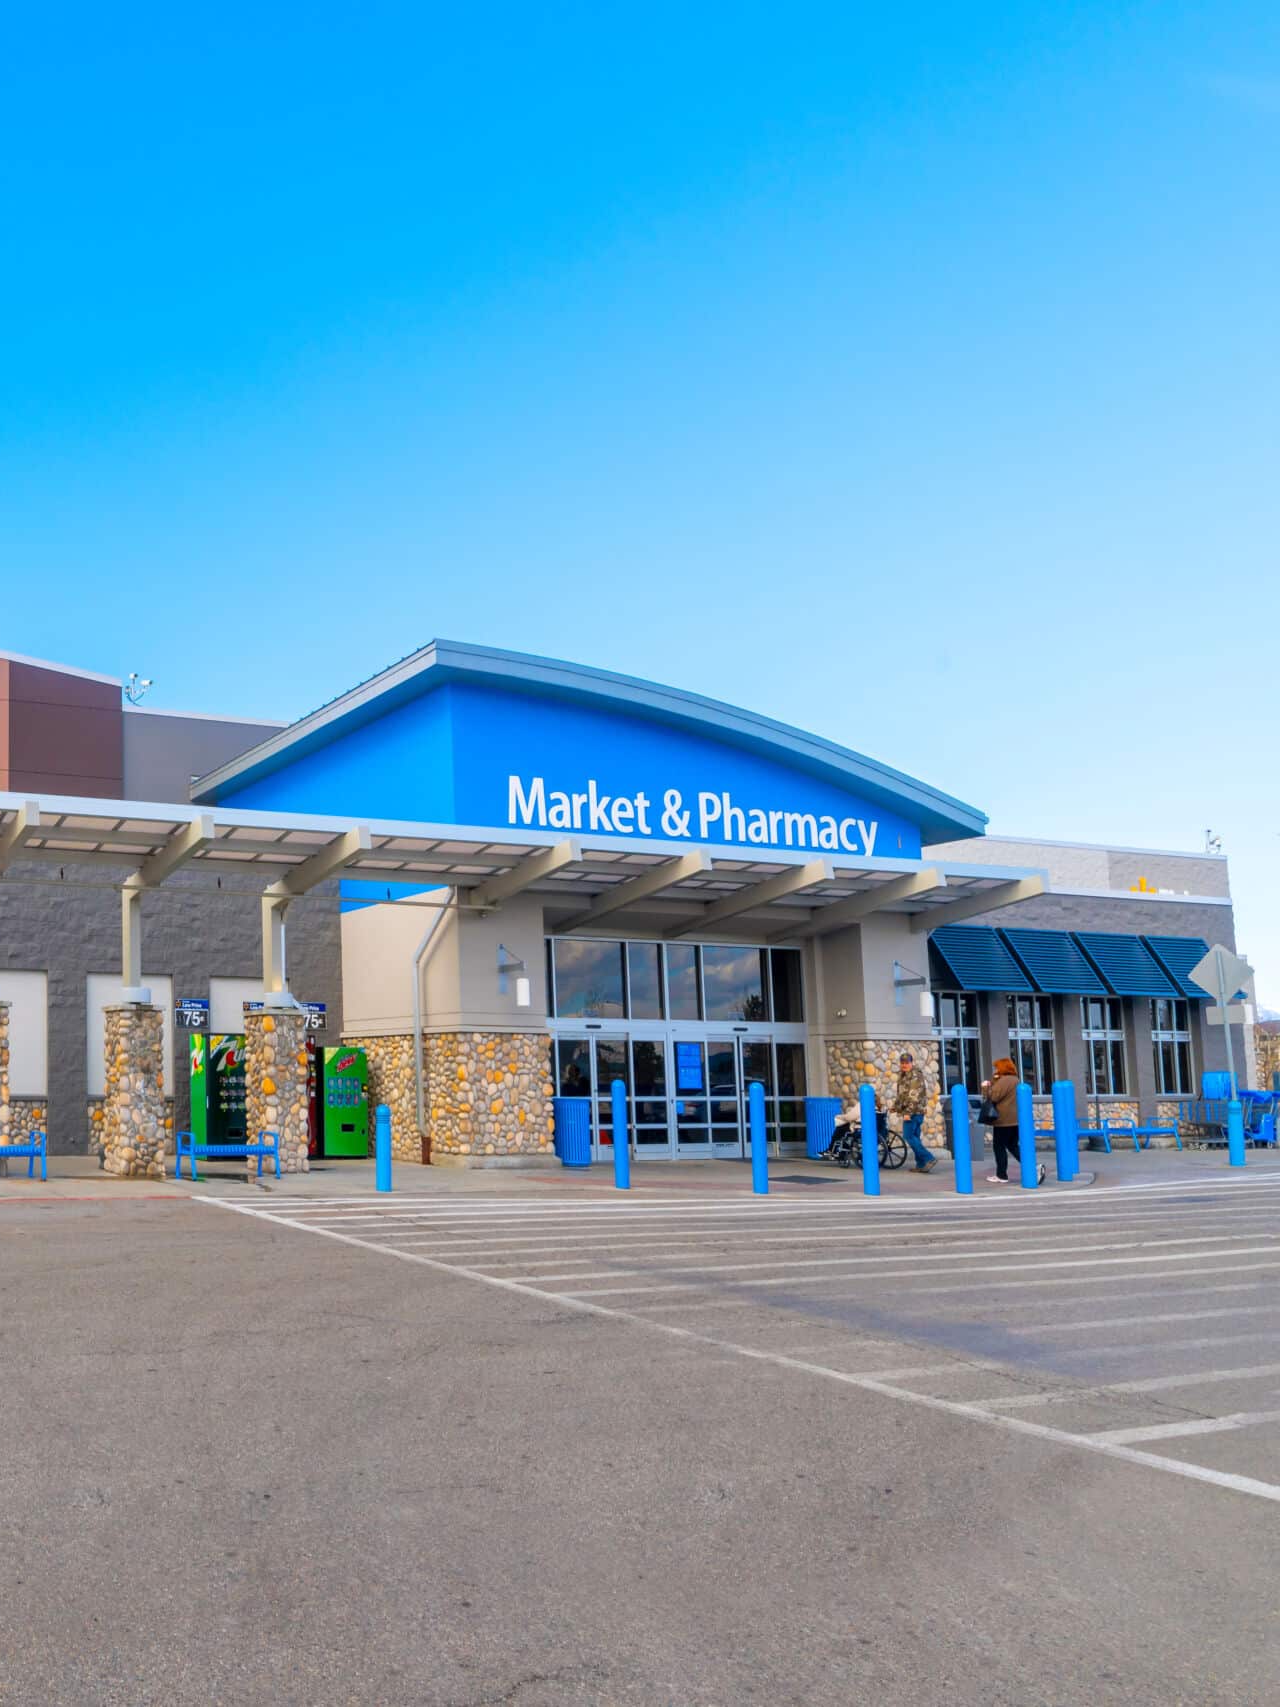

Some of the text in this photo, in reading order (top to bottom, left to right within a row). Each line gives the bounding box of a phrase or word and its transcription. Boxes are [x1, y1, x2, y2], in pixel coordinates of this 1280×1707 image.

[507, 775, 878, 857] Market & Pharmacy
